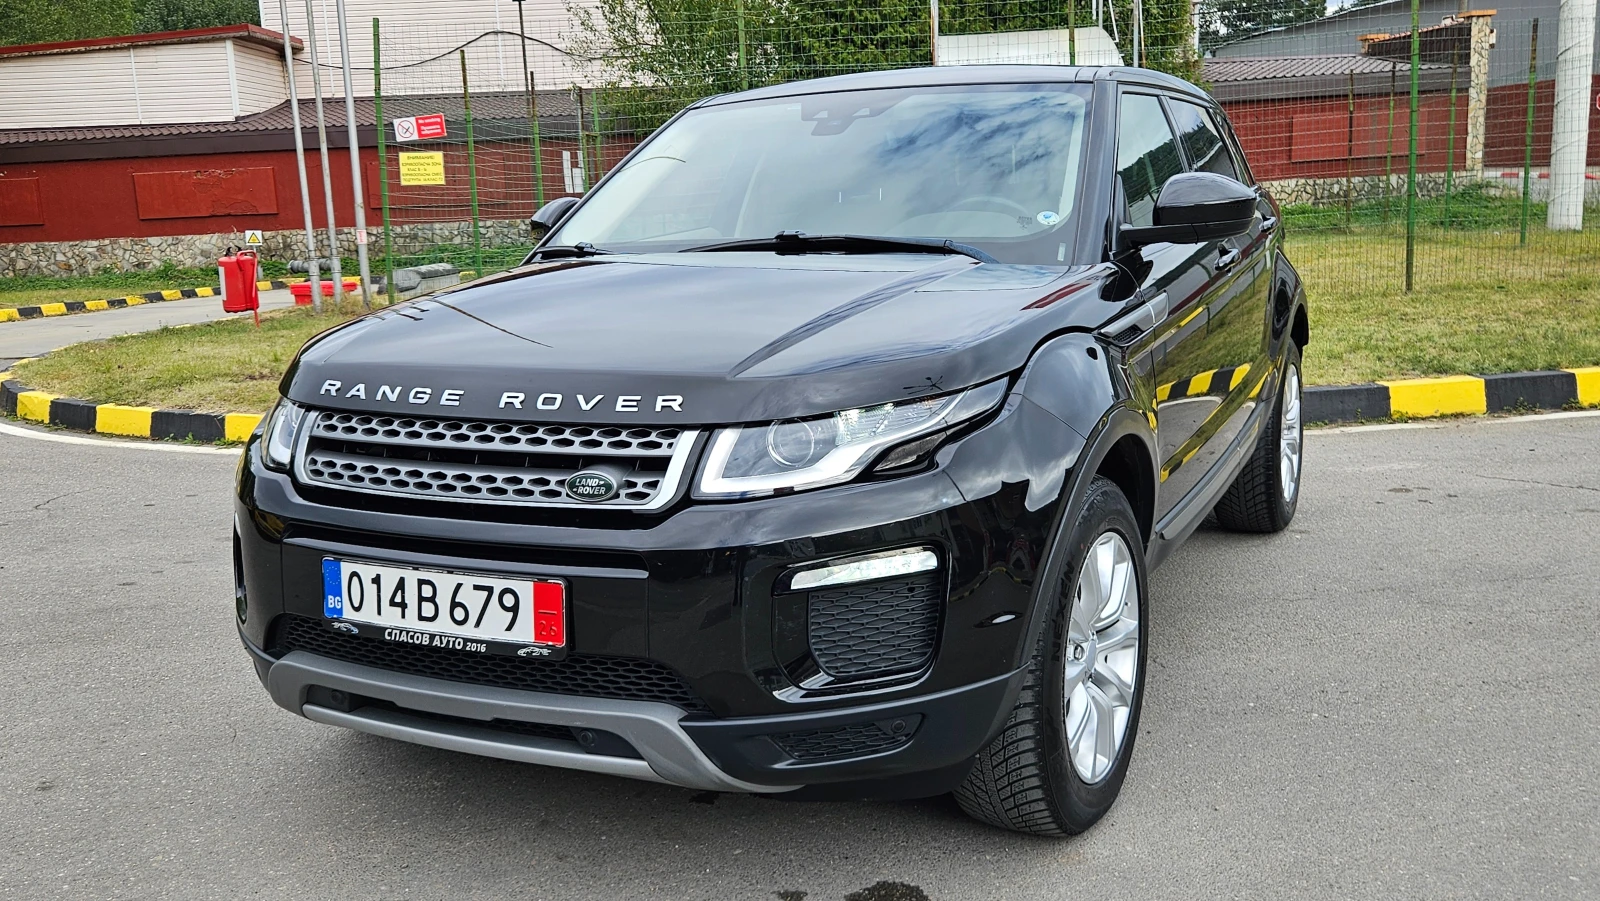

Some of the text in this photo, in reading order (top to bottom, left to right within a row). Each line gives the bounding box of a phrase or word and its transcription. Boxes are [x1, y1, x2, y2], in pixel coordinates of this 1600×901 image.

[319, 379, 684, 413] RANGE ROVER
[575, 478, 599, 487] LAND
[577, 486, 606, 495] ROVER
[327, 595, 342, 609] BG
[347, 570, 521, 633] 014B679
[1052, 561, 1075, 663] NEXEN
[539, 620, 557, 636] 26
[384, 628, 487, 653] СПАСОВ АУТО 2016
